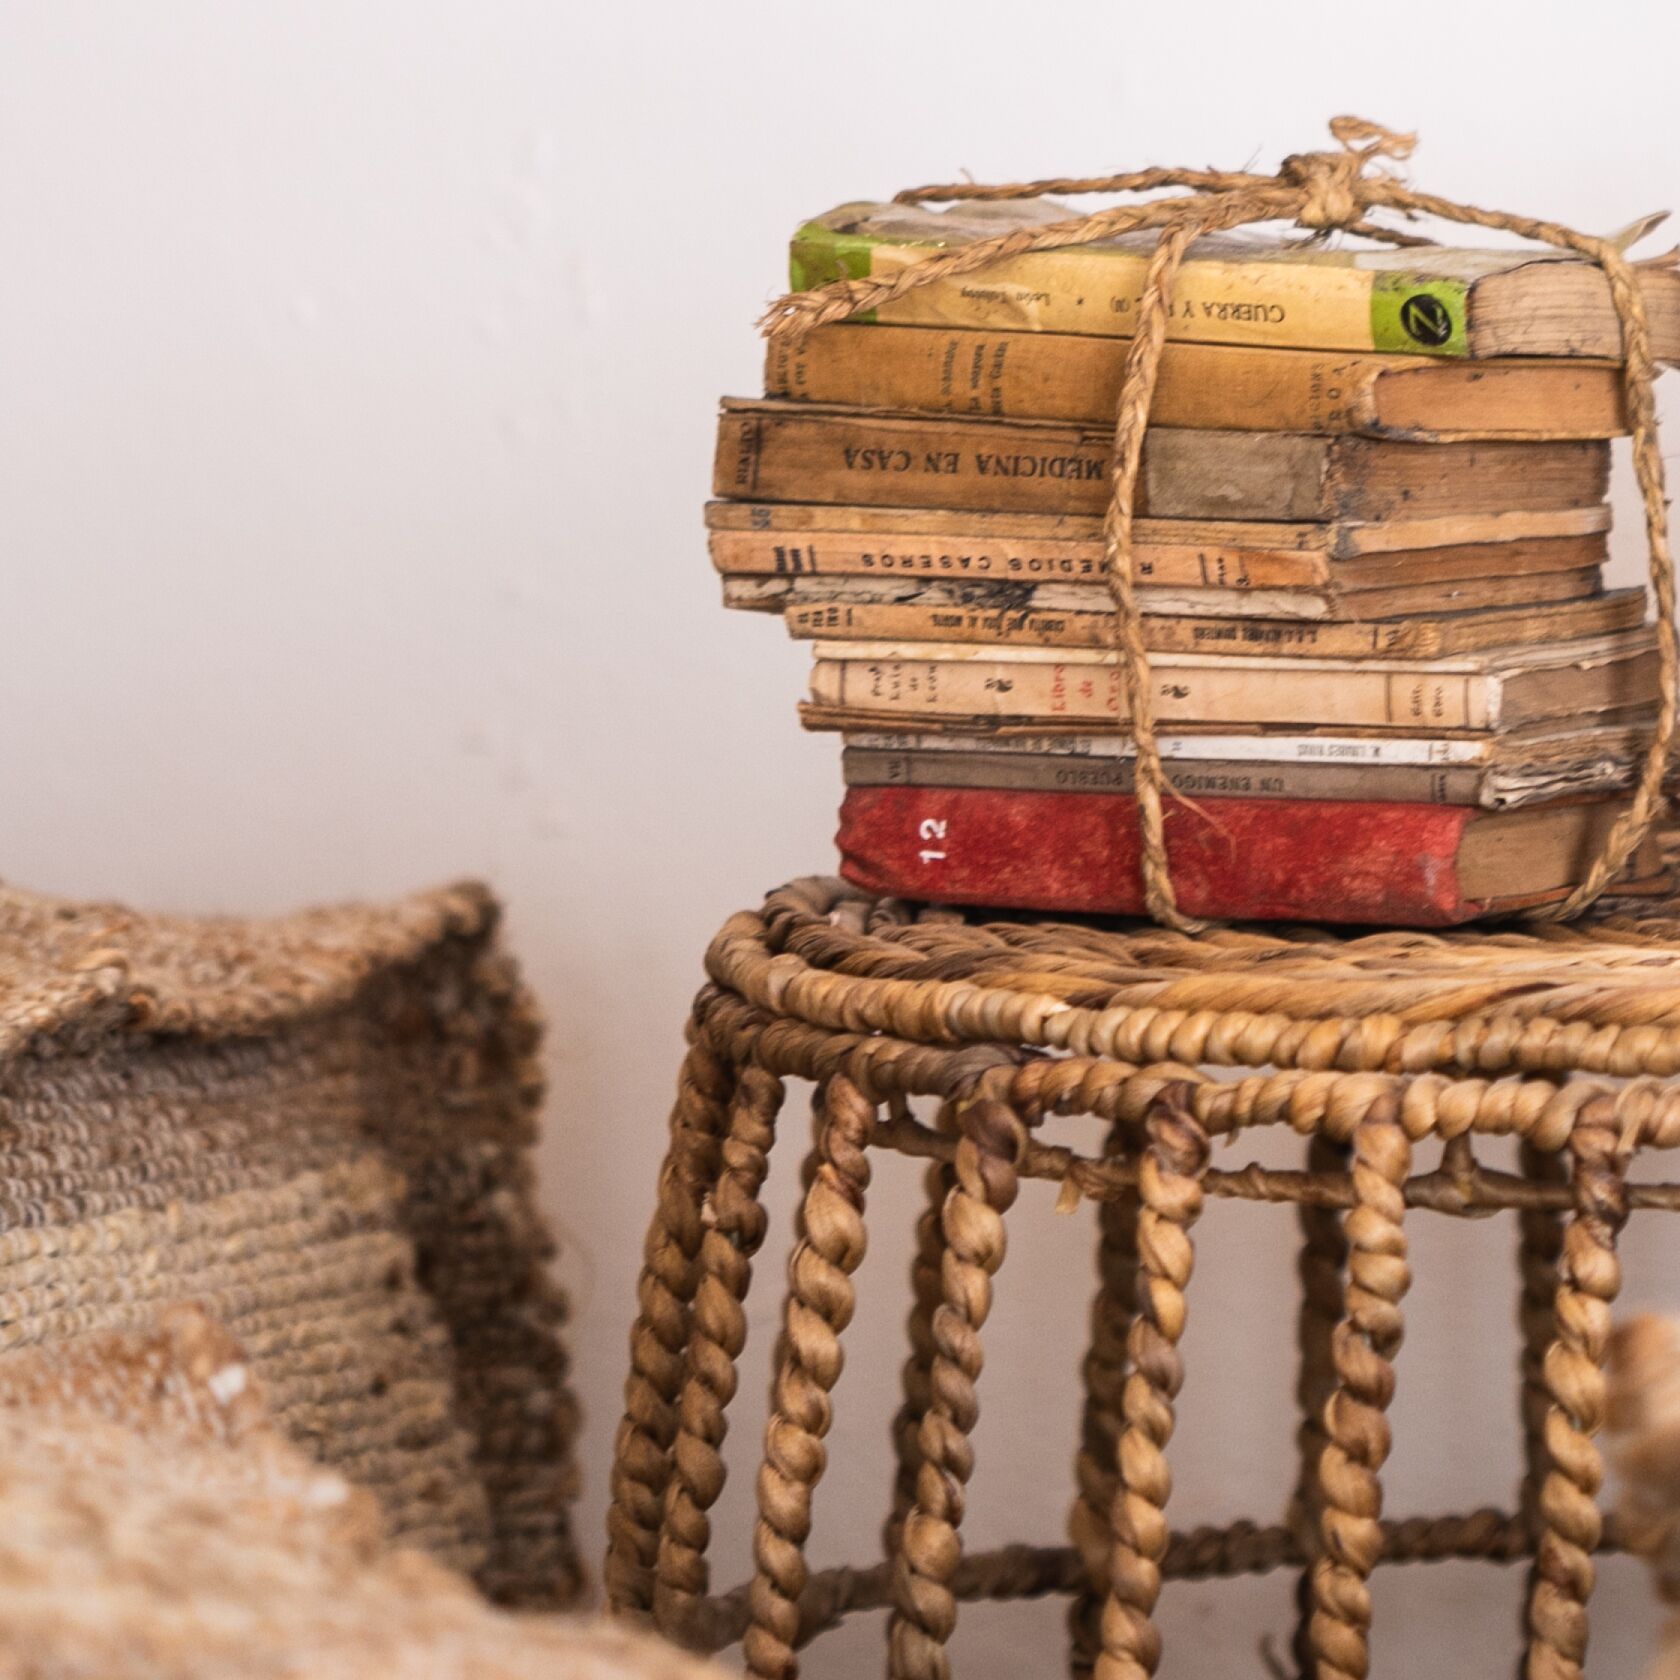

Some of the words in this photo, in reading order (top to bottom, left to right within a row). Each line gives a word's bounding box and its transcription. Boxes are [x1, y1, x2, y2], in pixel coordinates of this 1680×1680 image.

[1183, 299, 1195, 319] Y
[1202, 300, 1285, 323] GUERRA
[843, 446, 912, 473] CASA
[923, 451, 961, 474] EN
[975, 453, 1107, 481] MEDICINA
[861, 552, 992, 571] CASEROS
[1053, 663, 1066, 712] Libro
[1106, 670, 1121, 712] Oro
[1055, 769, 1123, 787] PUEBLO
[1170, 773, 1250, 793] ENEMIGO
[1259, 776, 1285, 793] UN
[918, 818, 948, 865] 12
